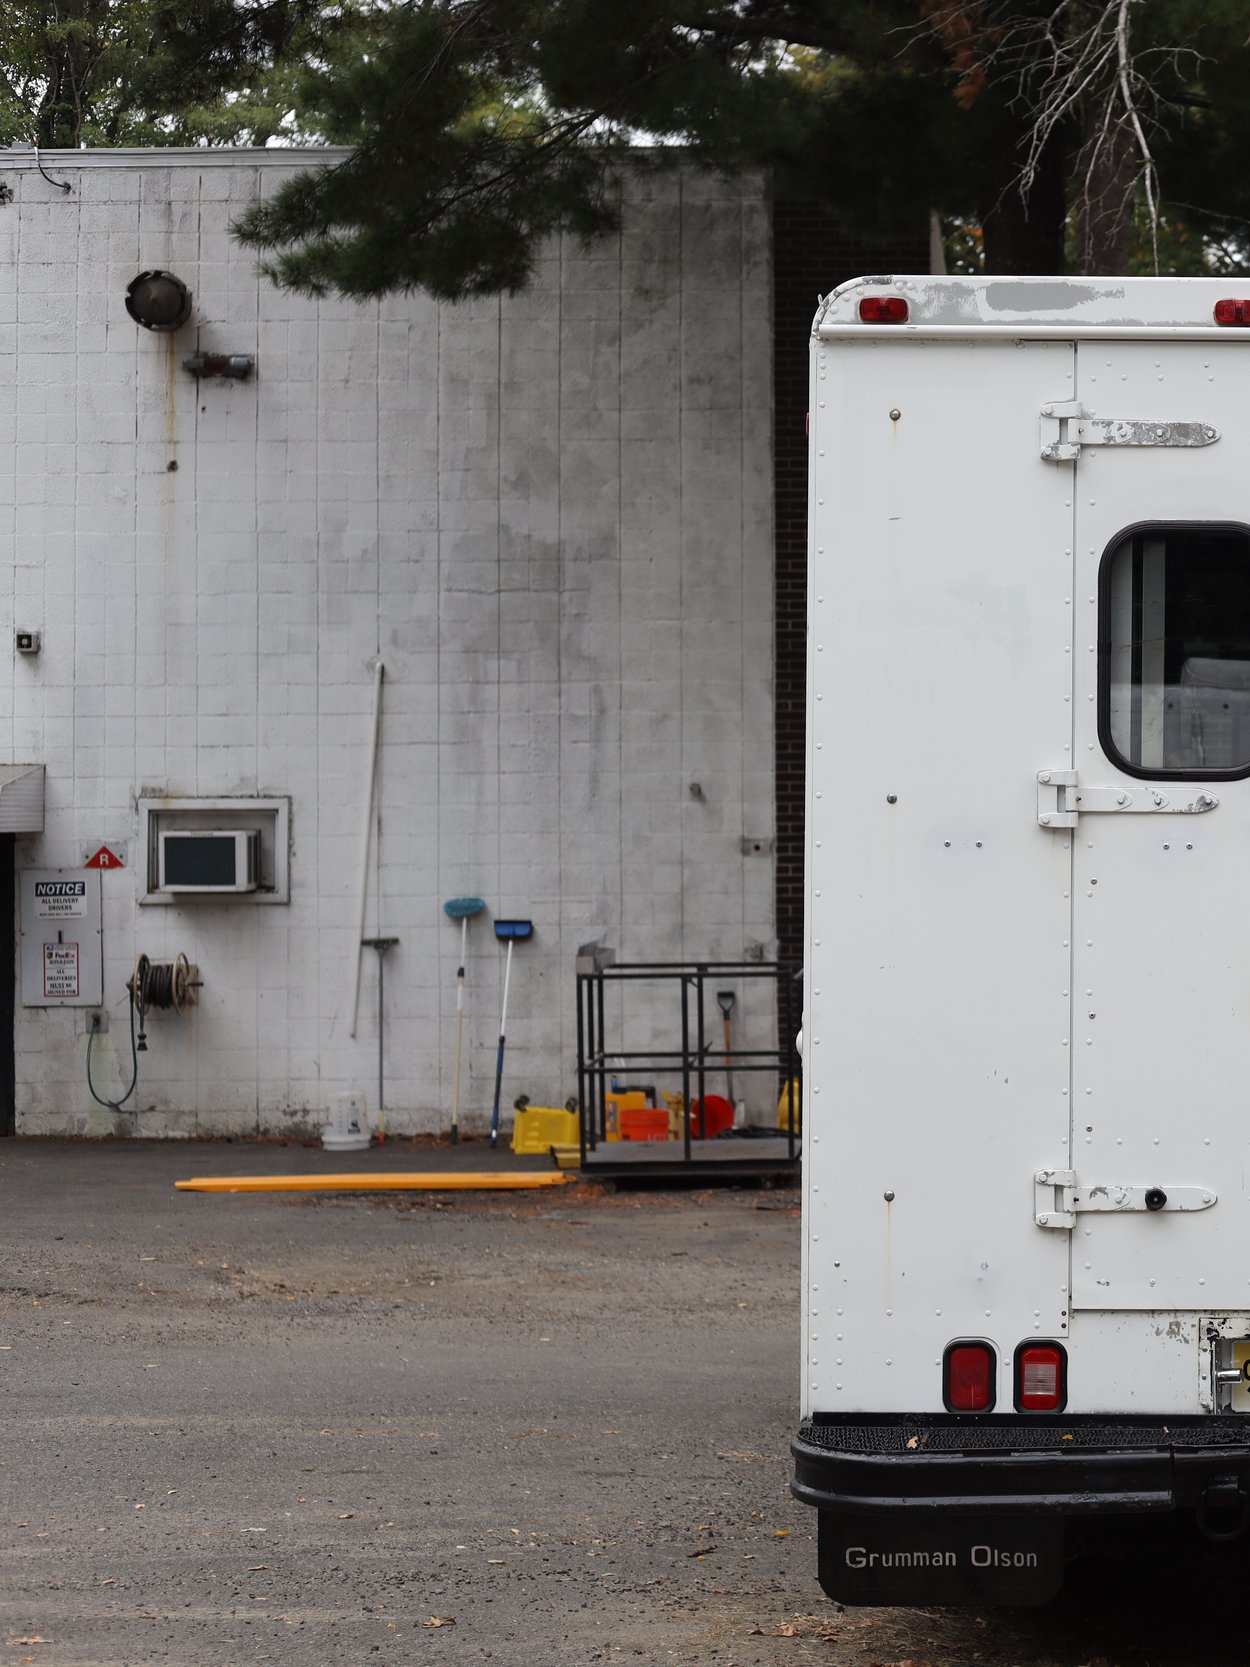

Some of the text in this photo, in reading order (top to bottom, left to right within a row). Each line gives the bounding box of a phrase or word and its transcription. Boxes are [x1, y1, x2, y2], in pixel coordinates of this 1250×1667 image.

[100, 853, 109, 866] R
[37, 883, 83, 896] NOTICE
[845, 1545, 1038, 1568] Grumman Olson
